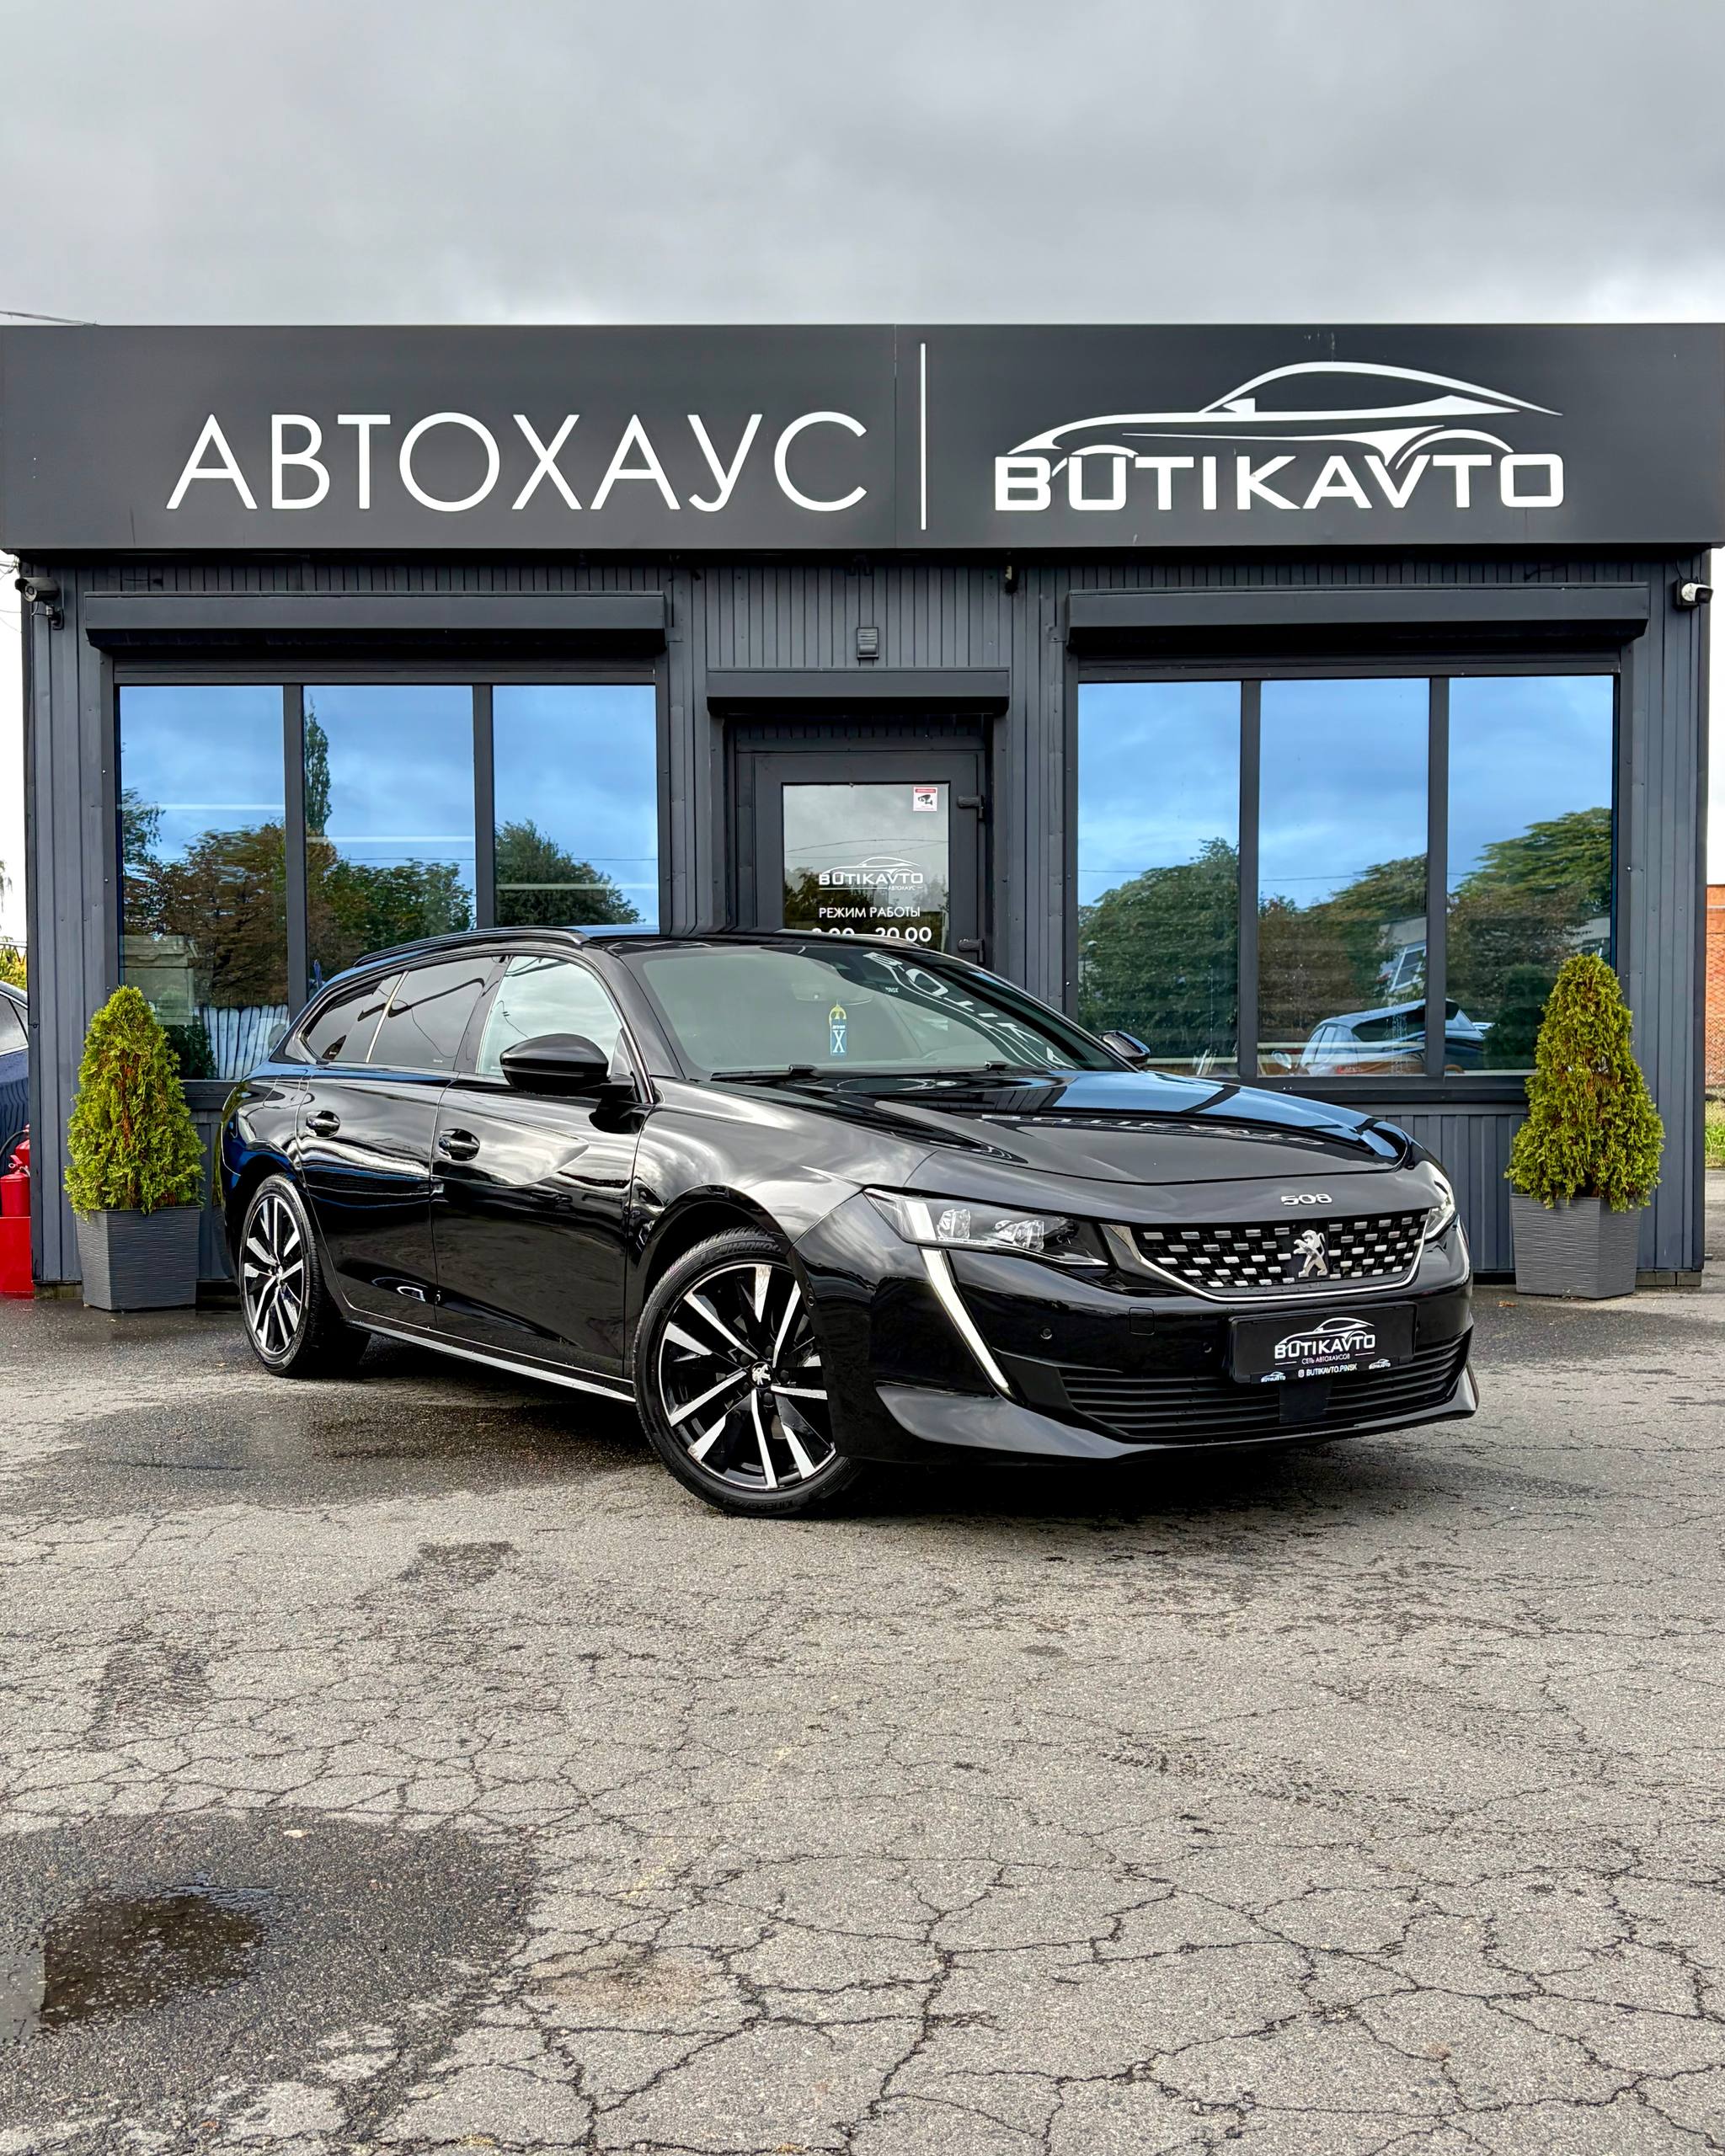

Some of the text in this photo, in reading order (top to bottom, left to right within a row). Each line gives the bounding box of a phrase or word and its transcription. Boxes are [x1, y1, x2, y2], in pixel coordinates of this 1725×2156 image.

[166, 411, 868, 513] АВТОХАУС
[994, 453, 1564, 511] BUTIKAVTO
[819, 873, 924, 885] BUTIKAVTO
[819, 906, 921, 919] РЕЖИМ РАБОТЫ
[1280, 1193, 1332, 1205] 508
[1274, 1334, 1375, 1359] BUTIKAVTO
[1301, 1353, 1351, 1365] СЕТЬ АВТОХАУСОВ
